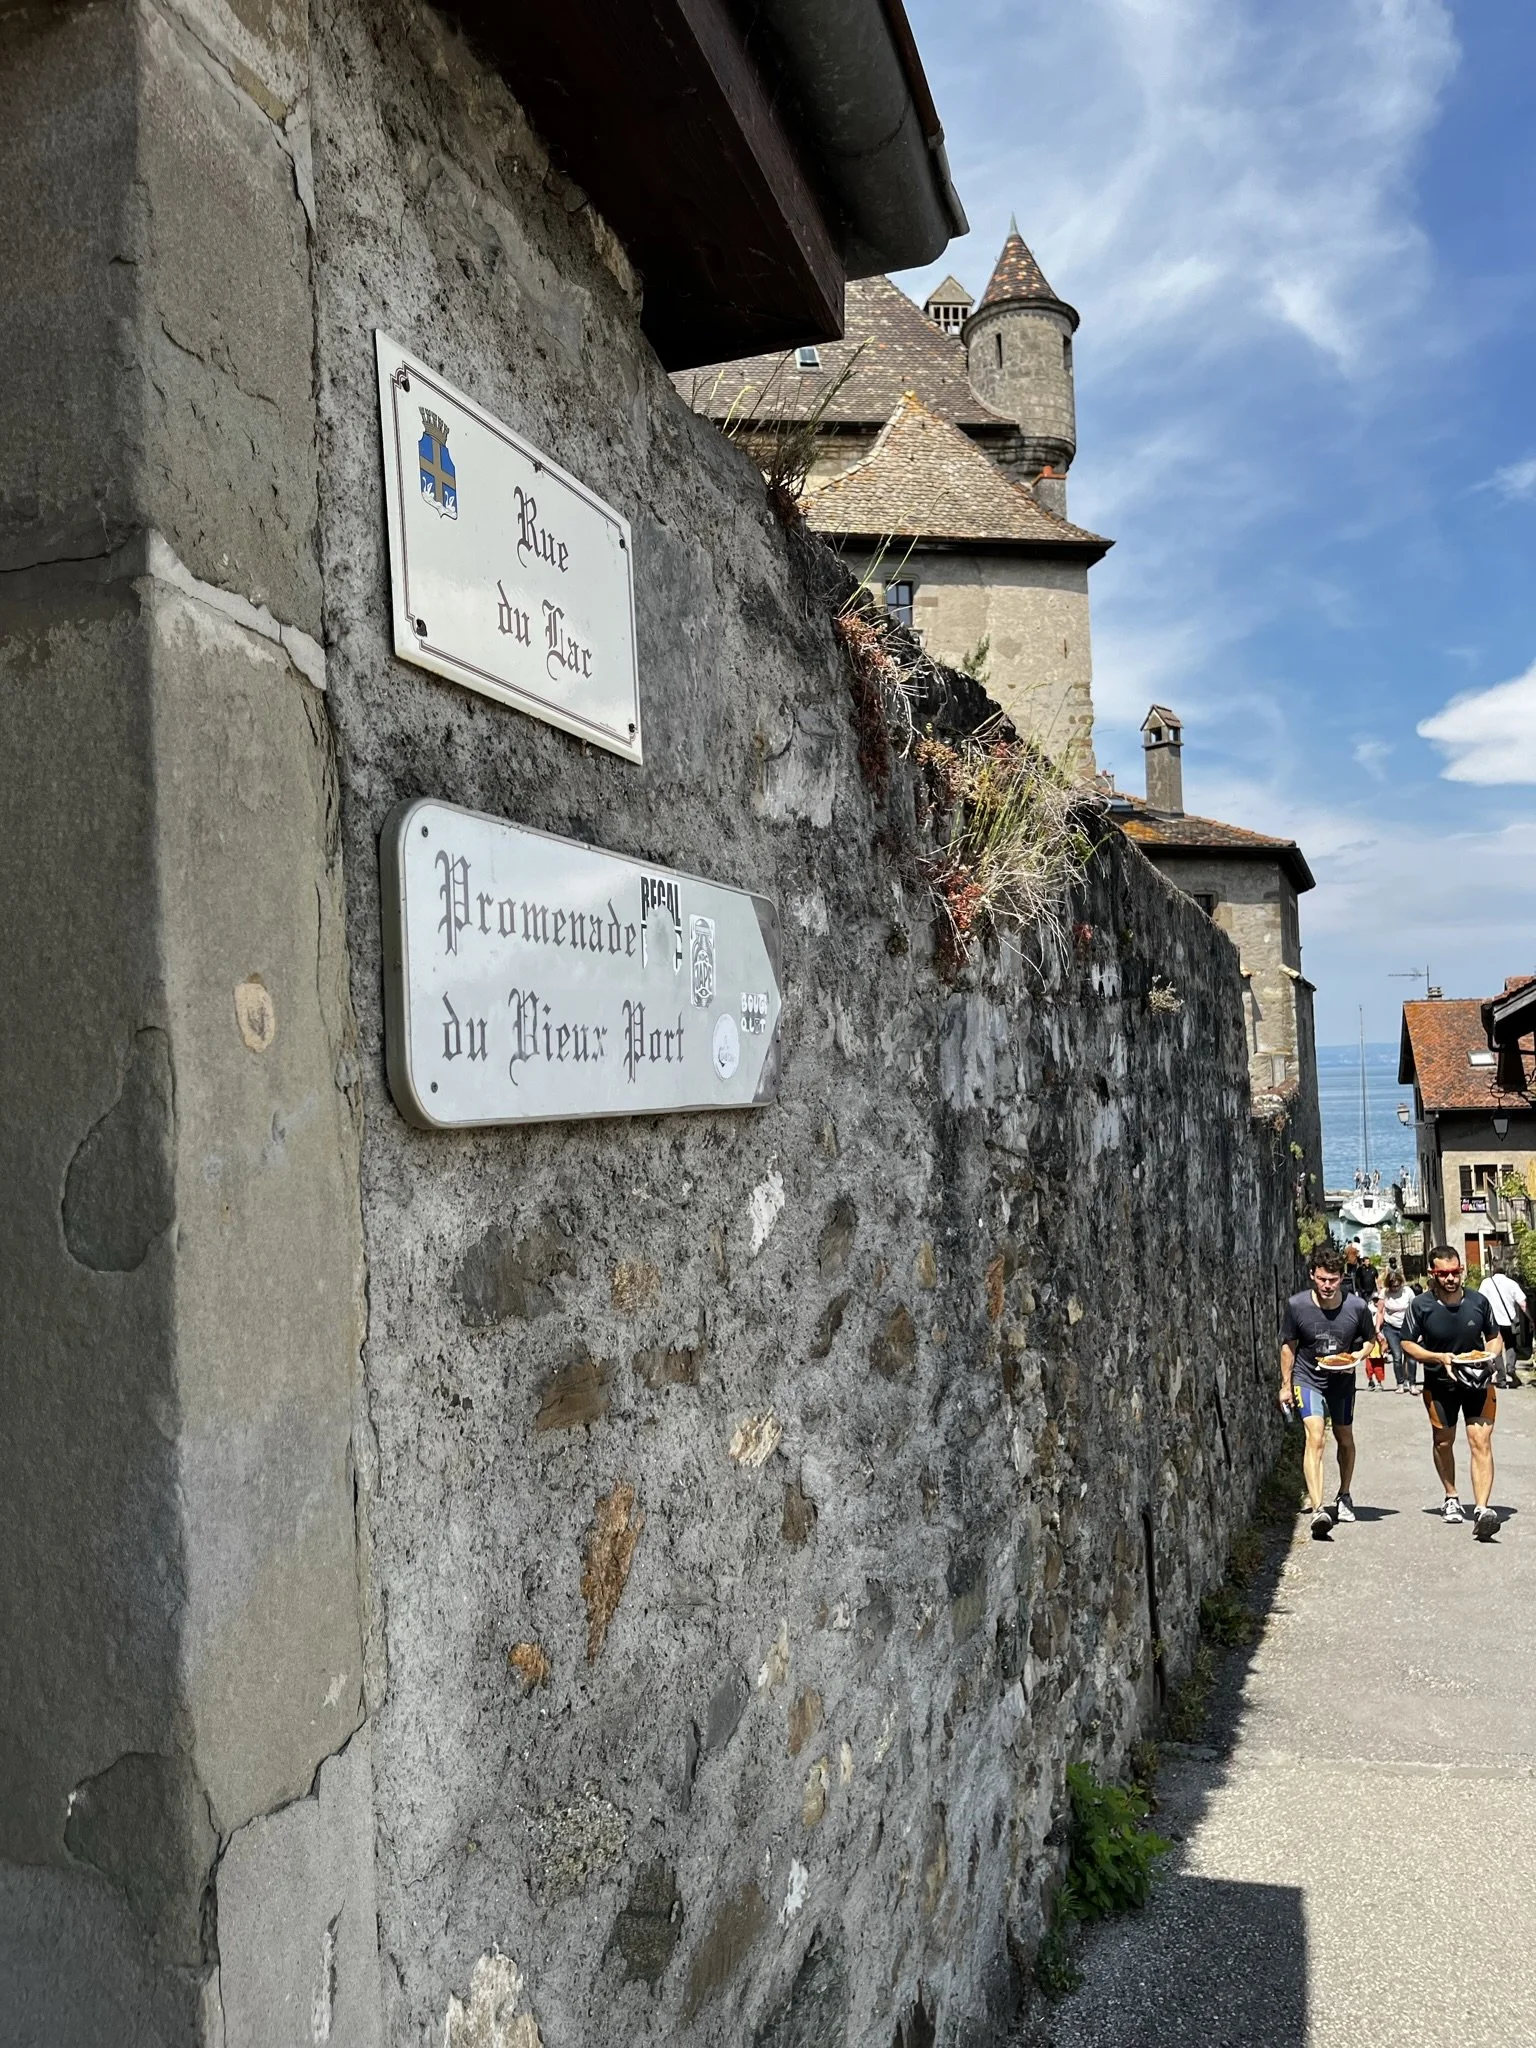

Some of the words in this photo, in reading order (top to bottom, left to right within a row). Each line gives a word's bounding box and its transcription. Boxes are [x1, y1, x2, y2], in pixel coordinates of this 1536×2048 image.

[513, 485, 569, 573] Rue
[496, 579, 531, 648] du
[542, 599, 593, 681] Lac
[434, 849, 638, 958] Promenade
[441, 991, 489, 1062] du
[508, 987, 608, 1087] Vieux
[622, 1000, 685, 1084] Port
